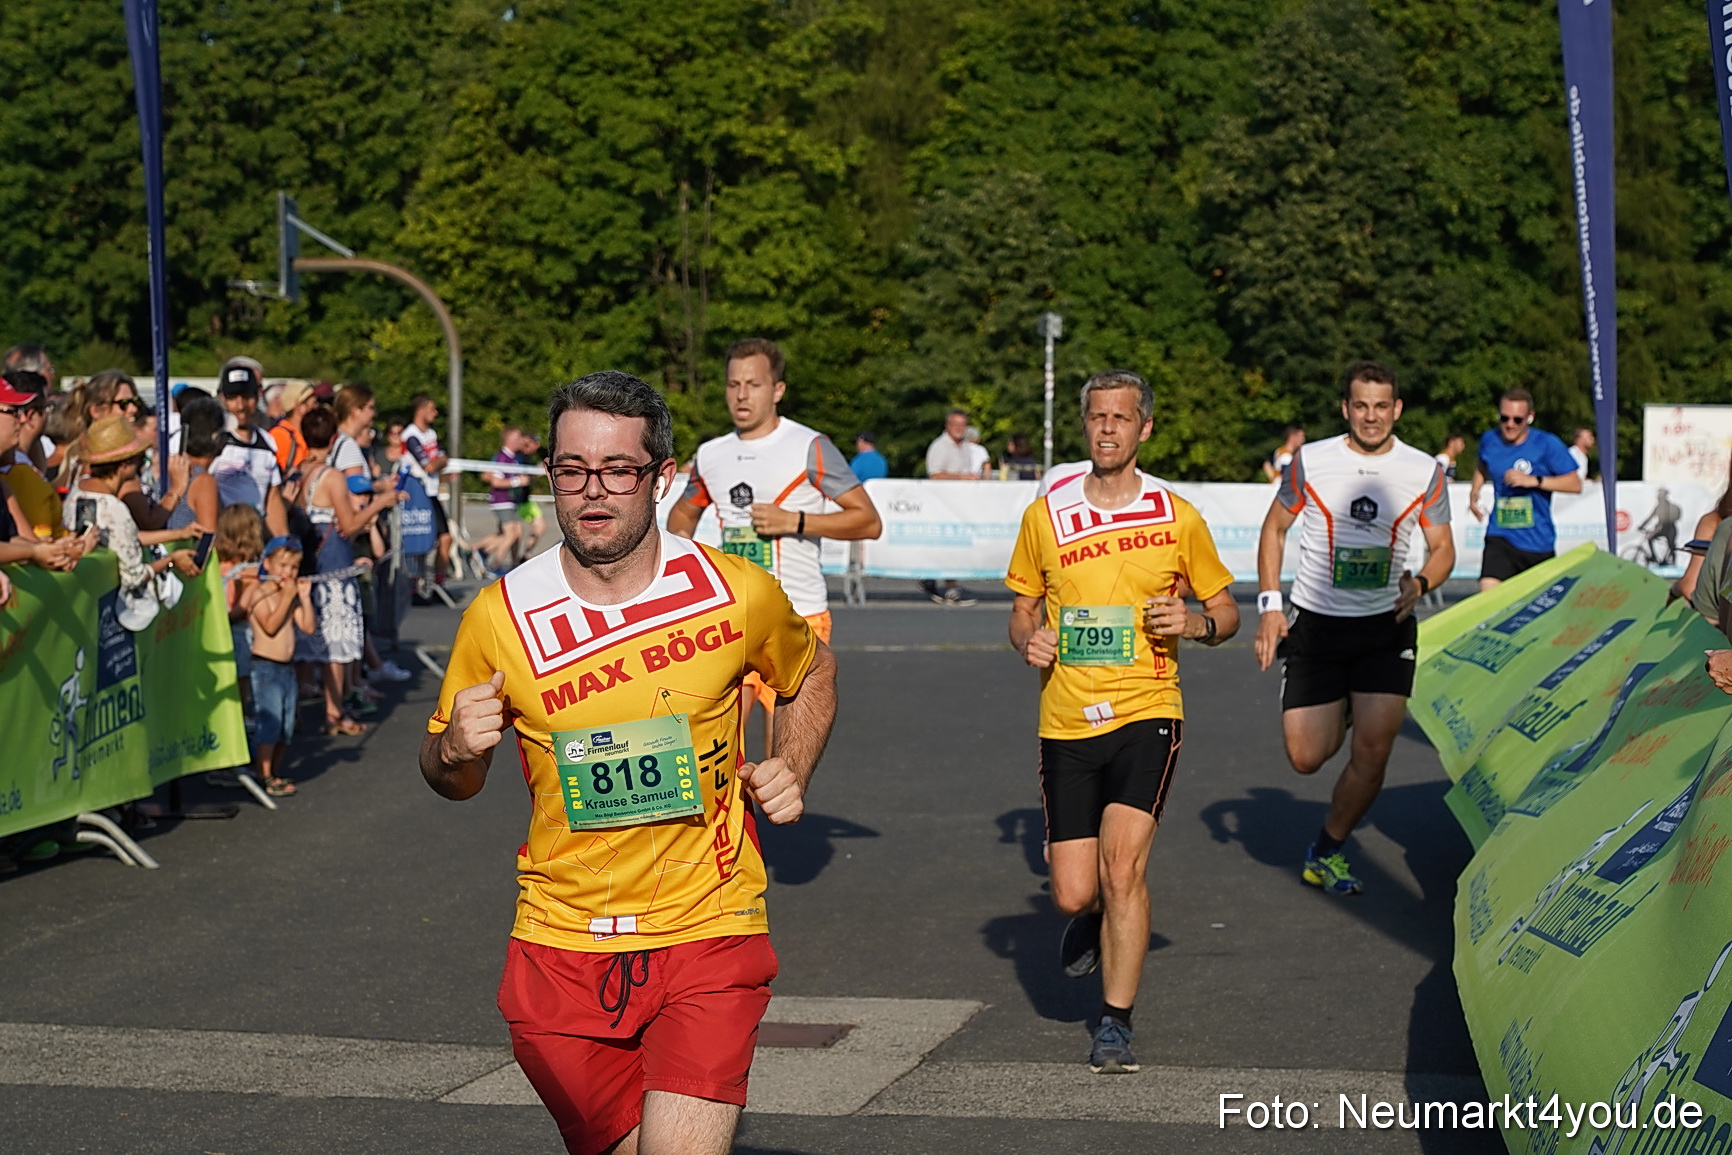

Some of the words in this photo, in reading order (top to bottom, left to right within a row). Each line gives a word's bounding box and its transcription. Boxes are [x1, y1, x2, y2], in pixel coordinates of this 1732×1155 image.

[731, 542, 758, 558] 373
[1059, 541, 1111, 568] MAX
[1118, 531, 1177, 553] BÖGL
[1349, 562, 1378, 576] 374
[1074, 627, 1114, 646] 799
[1122, 629, 1131, 657] 2022
[540, 657, 634, 716] MAX
[640, 620, 744, 674] BÖGL
[587, 740, 629, 756] Firmenlauf
[604, 748, 630, 757] neumarkt
[590, 754, 662, 795] 818
[675, 754, 695, 801] 2022
[567, 776, 584, 810] RUN
[585, 797, 628, 810] Krause
[630, 787, 679, 804] Samuel
